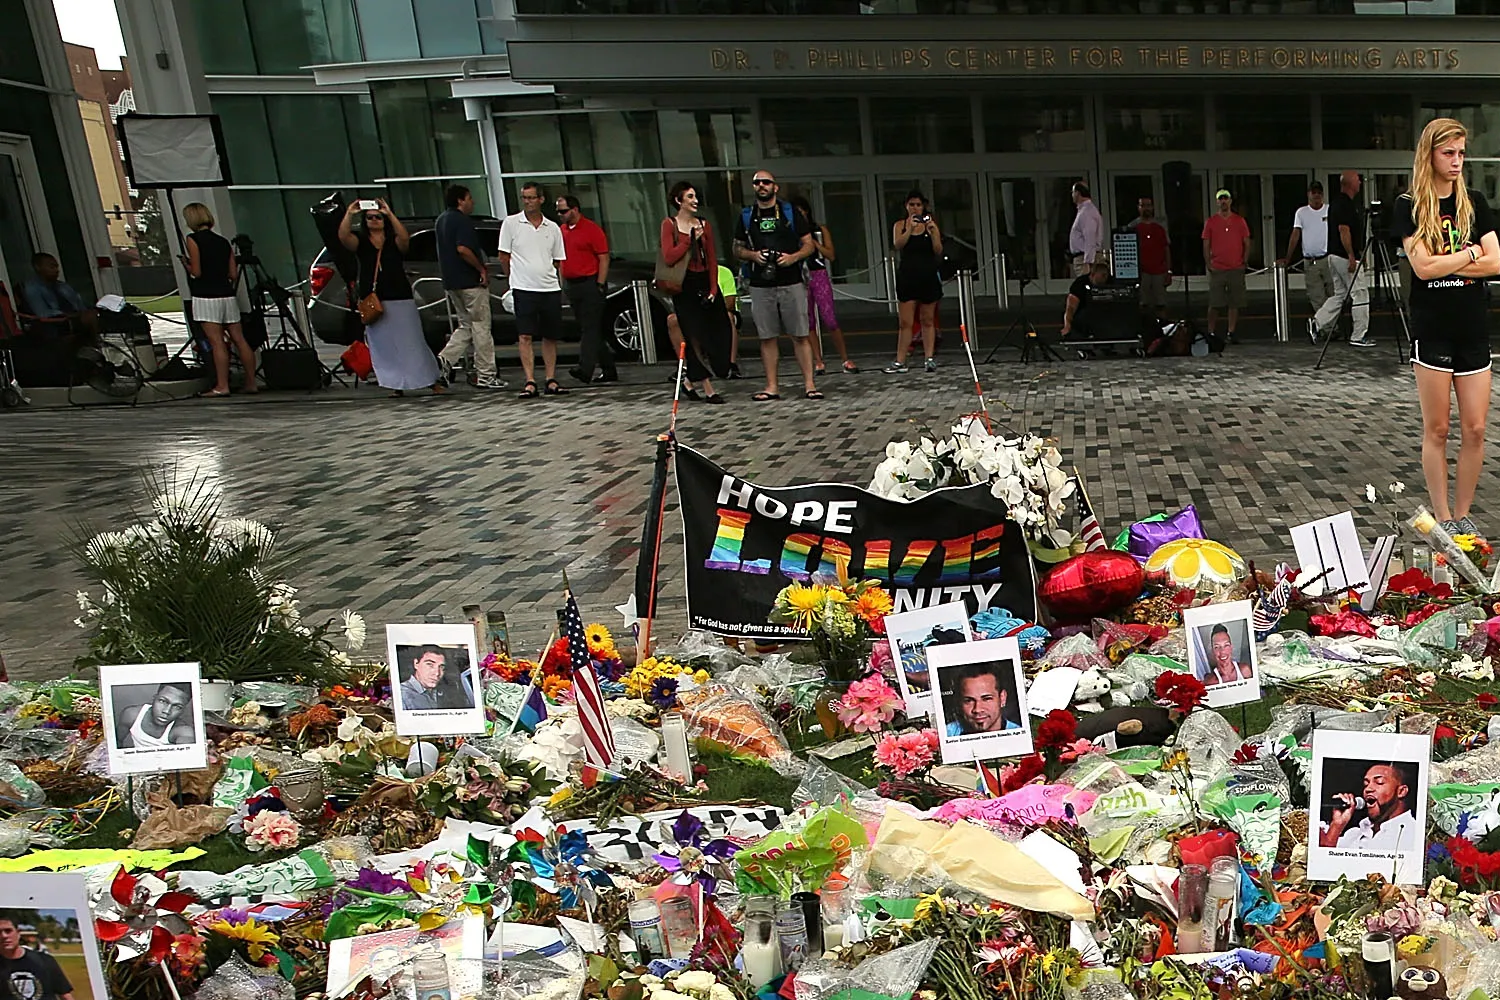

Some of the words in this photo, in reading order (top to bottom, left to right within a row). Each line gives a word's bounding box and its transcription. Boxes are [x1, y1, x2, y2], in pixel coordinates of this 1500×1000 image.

[807, 48, 931, 70] PHILLIPS
[946, 48, 1056, 70] CENTER
[1069, 48, 1124, 70] FOR
[1138, 48, 1190, 70] THE
[1202, 48, 1383, 70] PERFORMING
[1394, 48, 1460, 70] ARTS
[716, 474, 858, 534] HOPE
[704, 508, 1005, 584] LOVE
[886, 583, 1003, 612] NITY
[728, 622, 742, 632] not
[763, 625, 774, 633] us
